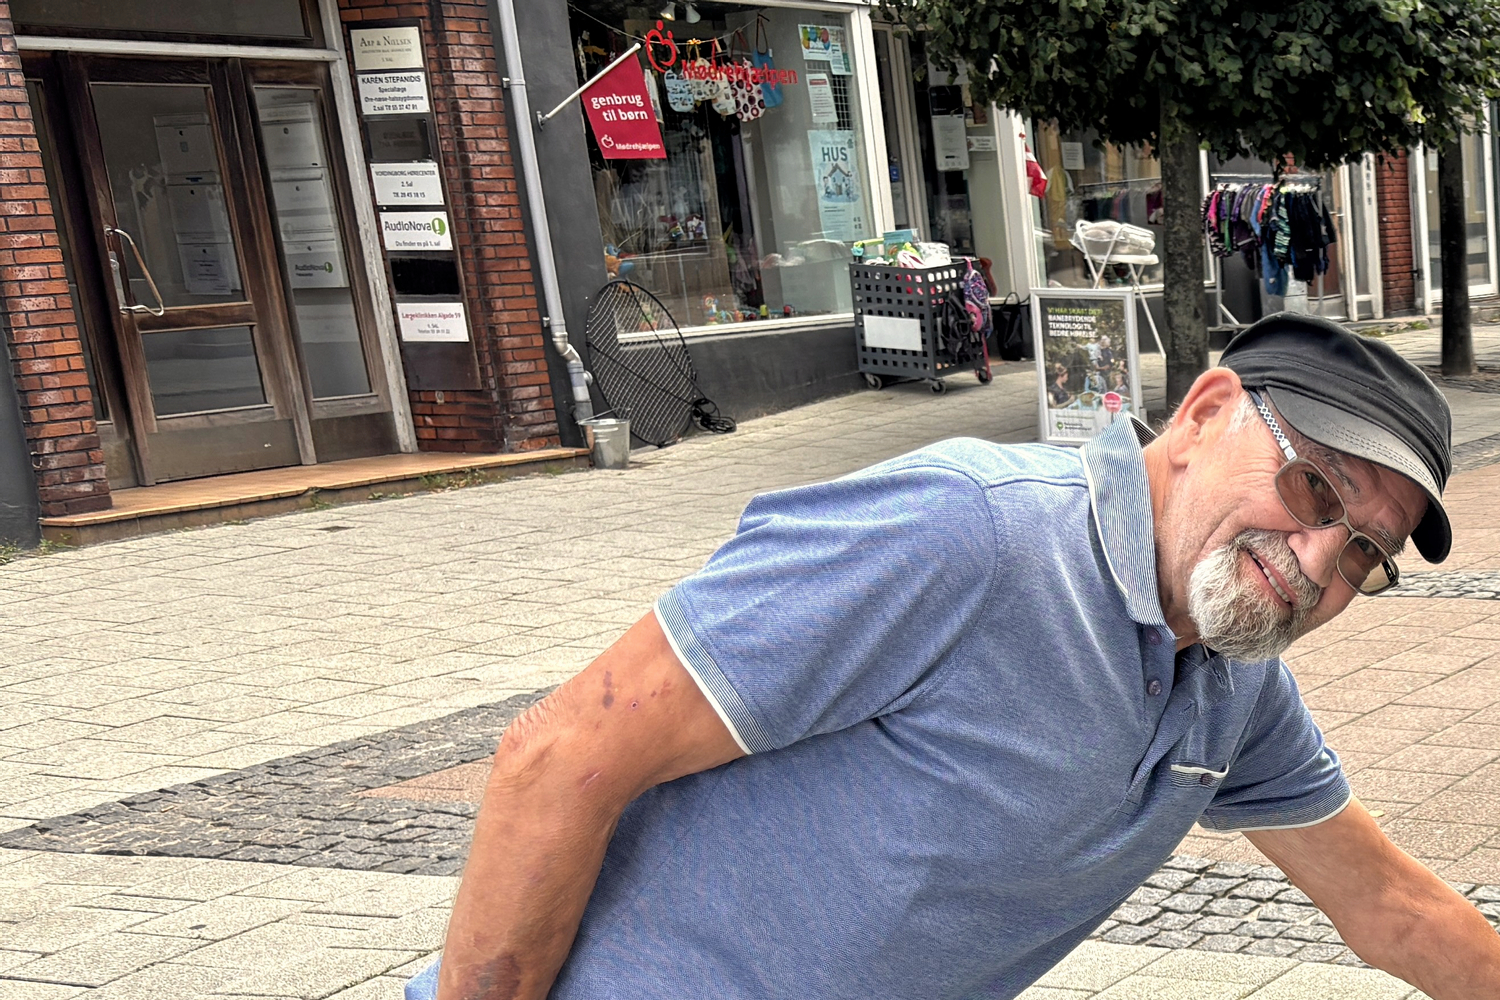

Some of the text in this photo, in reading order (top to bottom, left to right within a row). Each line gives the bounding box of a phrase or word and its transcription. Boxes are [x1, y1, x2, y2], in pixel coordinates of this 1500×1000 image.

[384, 75, 421, 83] STEPANIDIS
[681, 59, 798, 90] Mødrehjælpen
[591, 93, 644, 110] genbrug
[602, 108, 649, 122] til børn
[615, 142, 661, 151] Mødrehjælpen
[821, 146, 848, 162] HUS
[384, 221, 432, 231] AudioNova
[401, 312, 437, 320] Lægeklinikken
